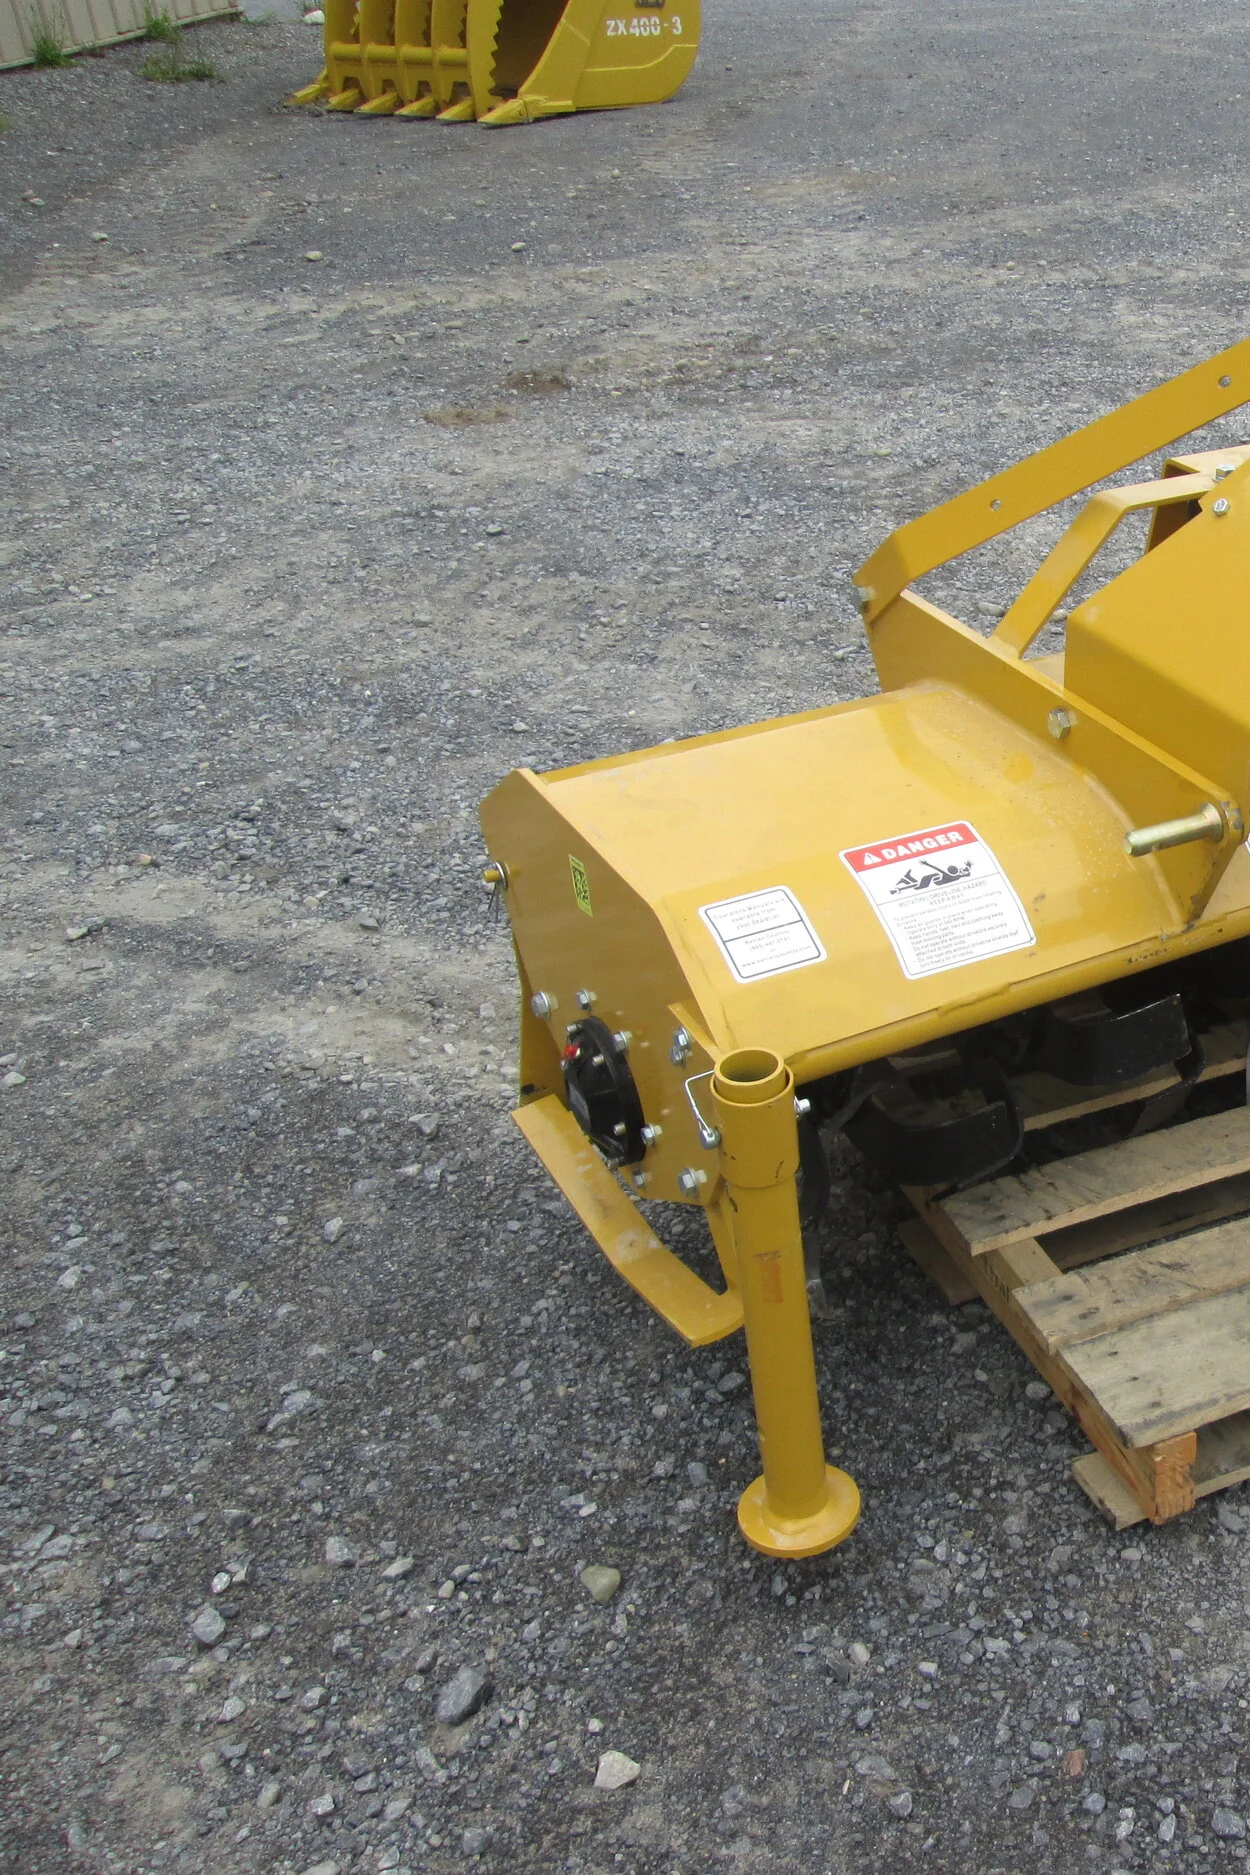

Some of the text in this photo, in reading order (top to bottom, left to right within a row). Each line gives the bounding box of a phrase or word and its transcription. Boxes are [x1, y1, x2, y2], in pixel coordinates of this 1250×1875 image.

[881, 831, 963, 859] DANGER
[898, 896, 929, 908] ROTATING
[962, 880, 987, 890] HAZARD
[946, 893, 964, 901] AWAY
